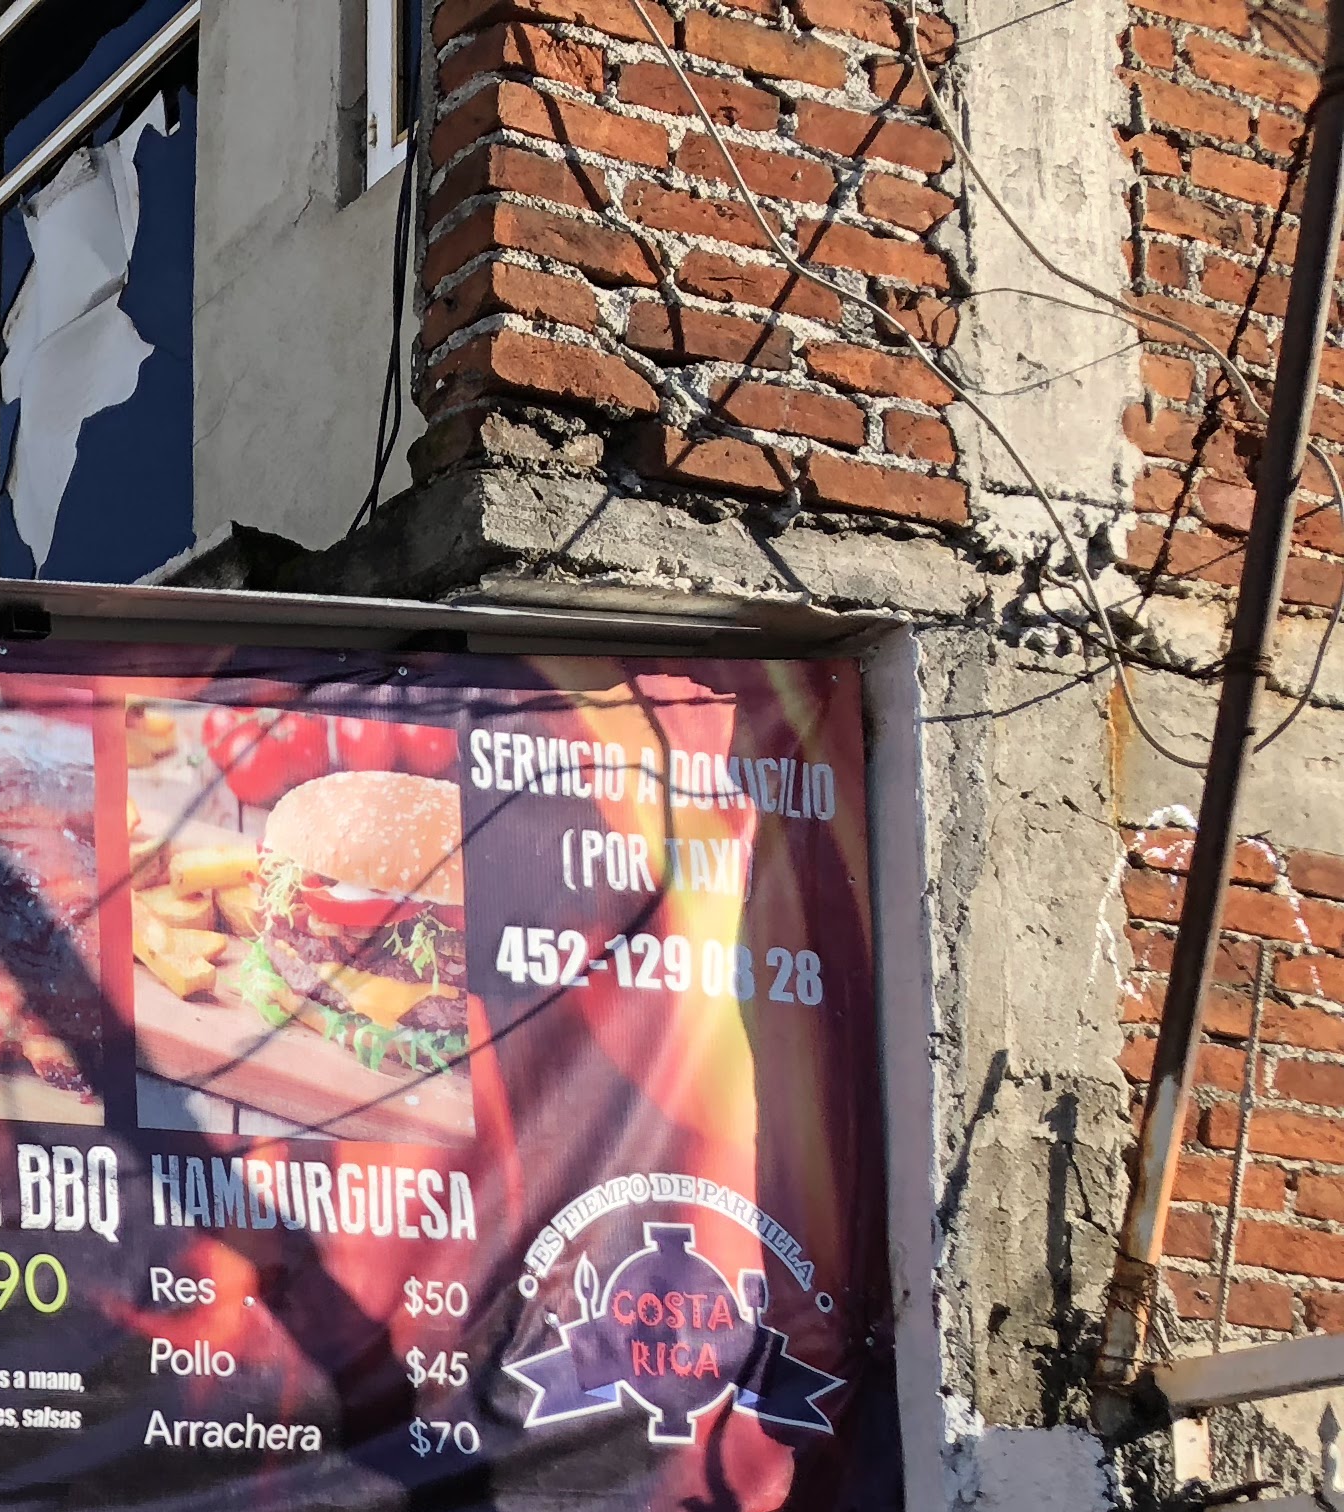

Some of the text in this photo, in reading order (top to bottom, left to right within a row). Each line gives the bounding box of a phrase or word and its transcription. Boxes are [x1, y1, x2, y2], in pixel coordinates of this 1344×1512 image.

[469, 728, 835, 820] SERVICIO A DOMICILIO
[562, 828, 656, 892] (POR
[496, 925, 824, 1005] 452-129 08 28
[17, 1143, 119, 1243] BBQ
[152, 1153, 477, 1241] HAMBURGUESA
[552, 1175, 649, 1237] TIEMPO
[652, 1174, 695, 1200] DE
[700, 1179, 813, 1288] PARRILLA
[149, 1267, 216, 1304] Res
[404, 1276, 468, 1318] $50
[612, 1291, 734, 1331] COSTA
[150, 1338, 236, 1377] Pollo
[406, 1346, 469, 1388] $45
[631, 1341, 719, 1380] RICA
[13, 1372, 26, 1390] a
[28, 1372, 85, 1393] mano,
[22, 1406, 82, 1429] salsas
[144, 1410, 322, 1452] Arrachera
[408, 1417, 480, 1458] $70
